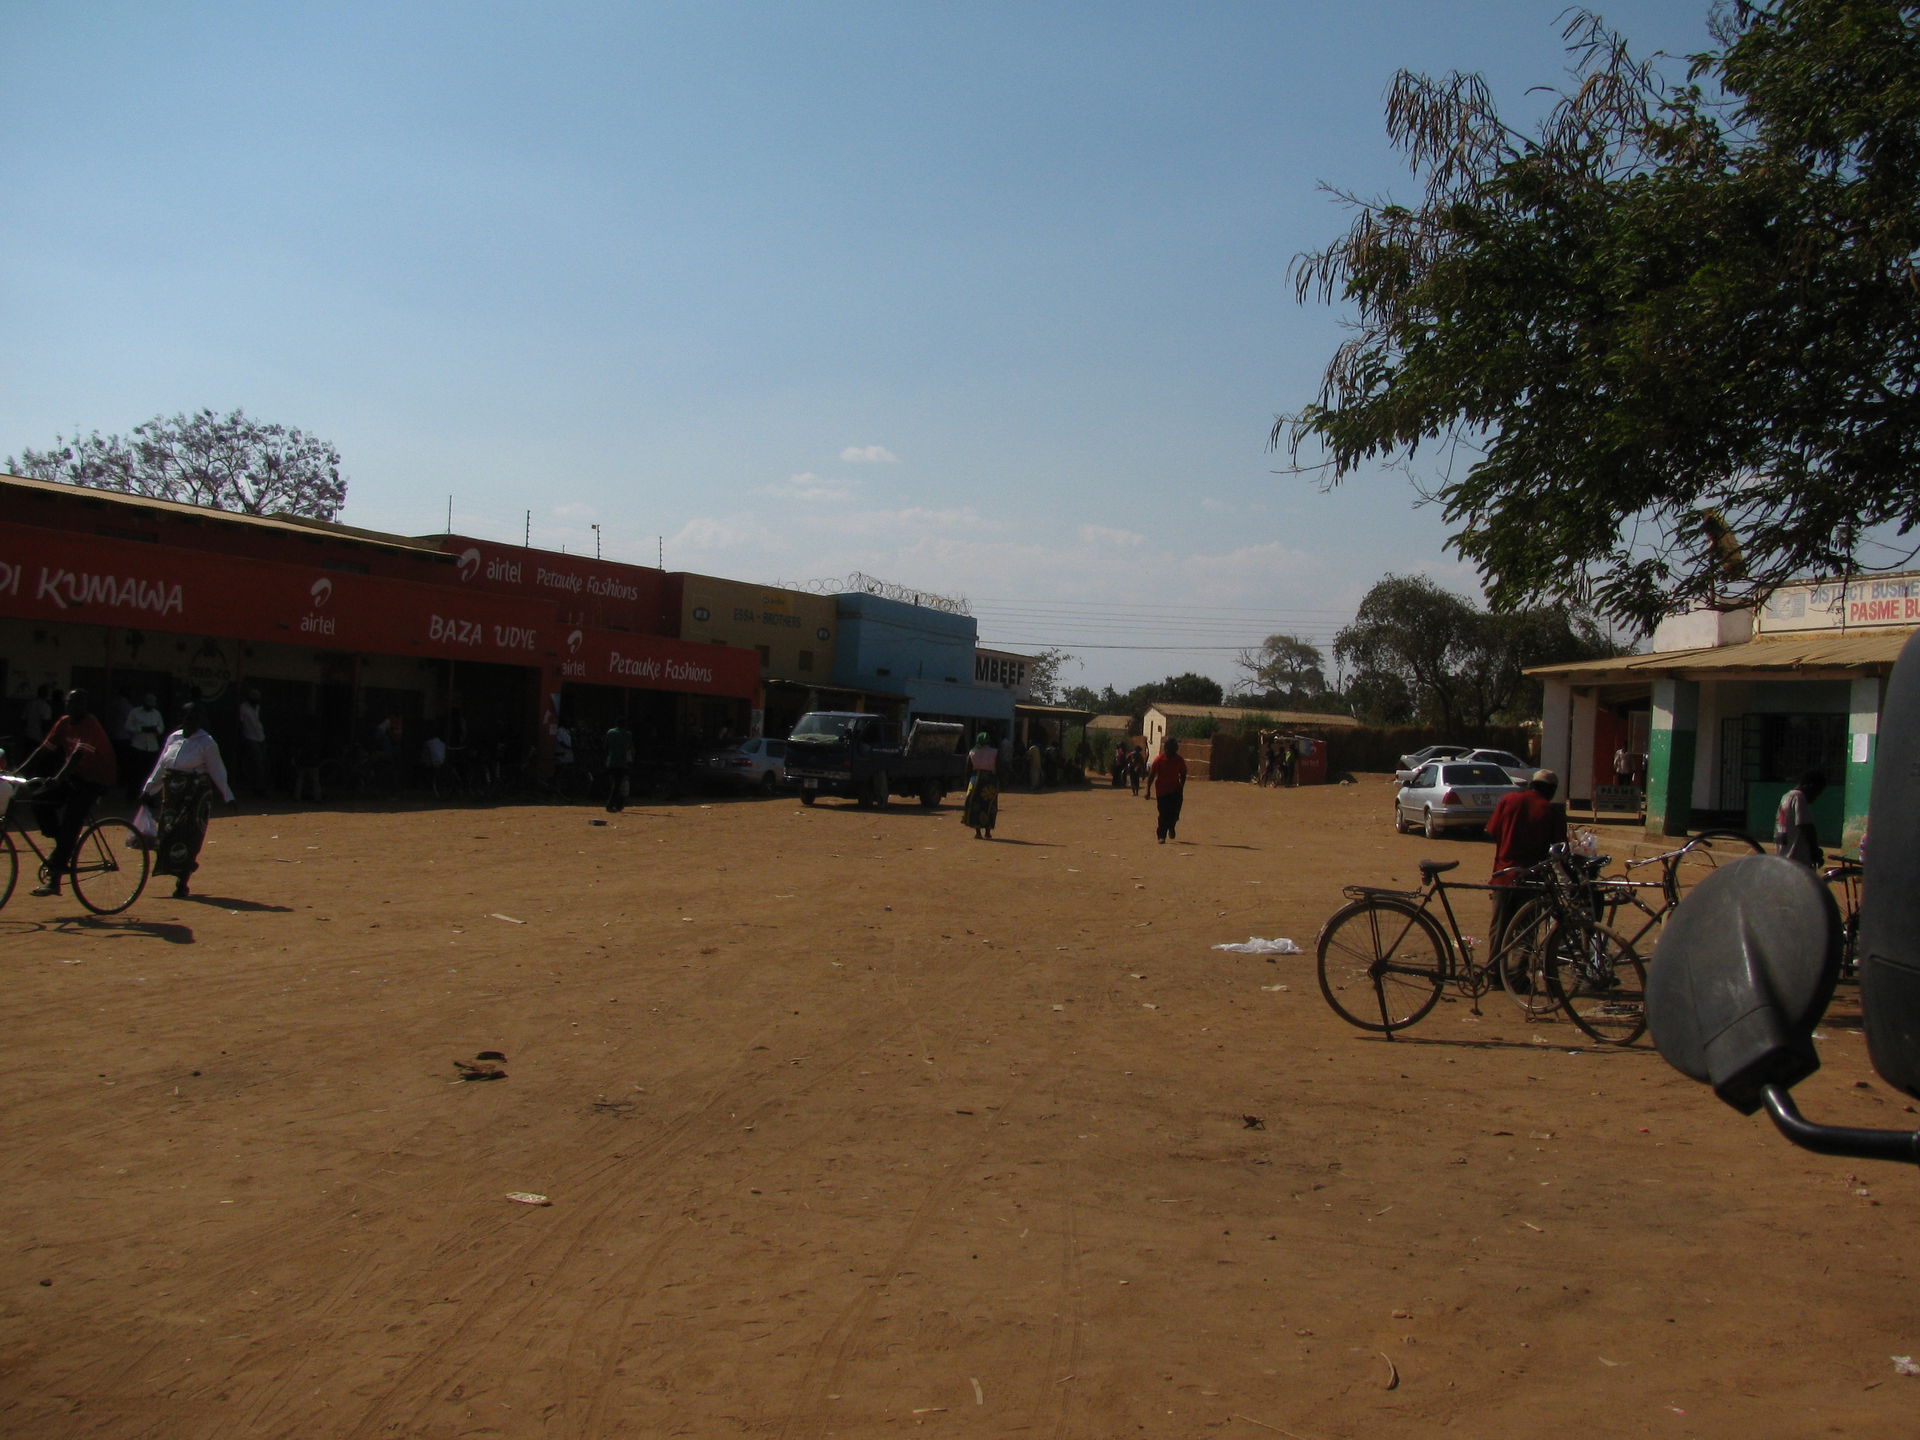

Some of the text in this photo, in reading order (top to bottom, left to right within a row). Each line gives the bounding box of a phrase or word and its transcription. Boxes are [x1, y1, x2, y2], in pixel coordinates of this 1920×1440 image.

[487, 558, 522, 584] airtel
[536, 568, 638, 602] Petauke Fashions
[36, 567, 183, 616] KUMAWA
[300, 614, 335, 635] airtel
[1850, 600, 1899, 621] PASME
[430, 614, 482, 647] BAZA
[562, 659, 586, 678] airtel
[609, 651, 713, 684] Petauke Fashions
[975, 653, 1024, 685] MBEEF
